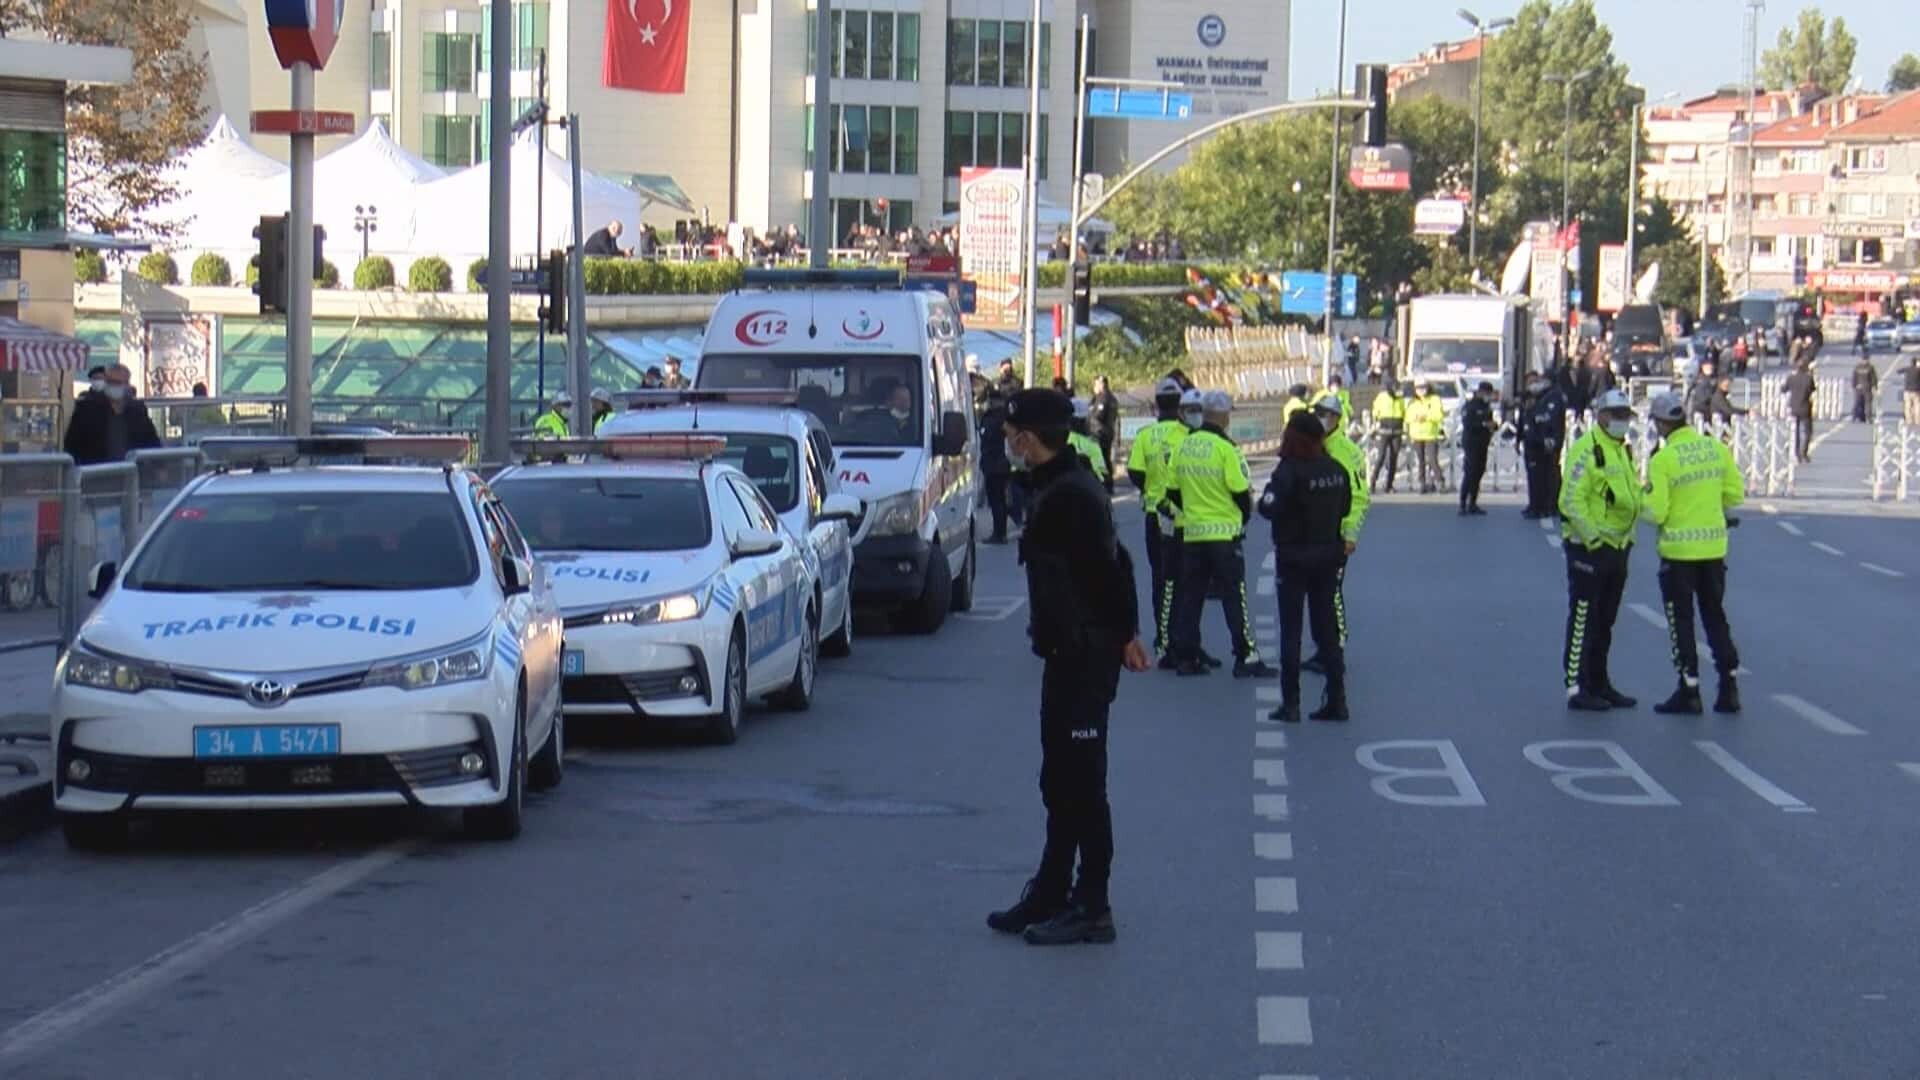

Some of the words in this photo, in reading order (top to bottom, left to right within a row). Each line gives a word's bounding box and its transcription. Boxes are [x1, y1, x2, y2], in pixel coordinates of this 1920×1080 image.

[1156, 57, 1203, 68] MARMARA
[749, 319, 788, 335] 112
[554, 566, 650, 583] POLİSİ
[143, 612, 280, 640] TRAFİK
[291, 613, 416, 637] POLİSİ
[209, 730, 235, 754] 34
[252, 729, 264, 753] A
[279, 728, 329, 753] 5471
[1071, 728, 1098, 739] POLİS
